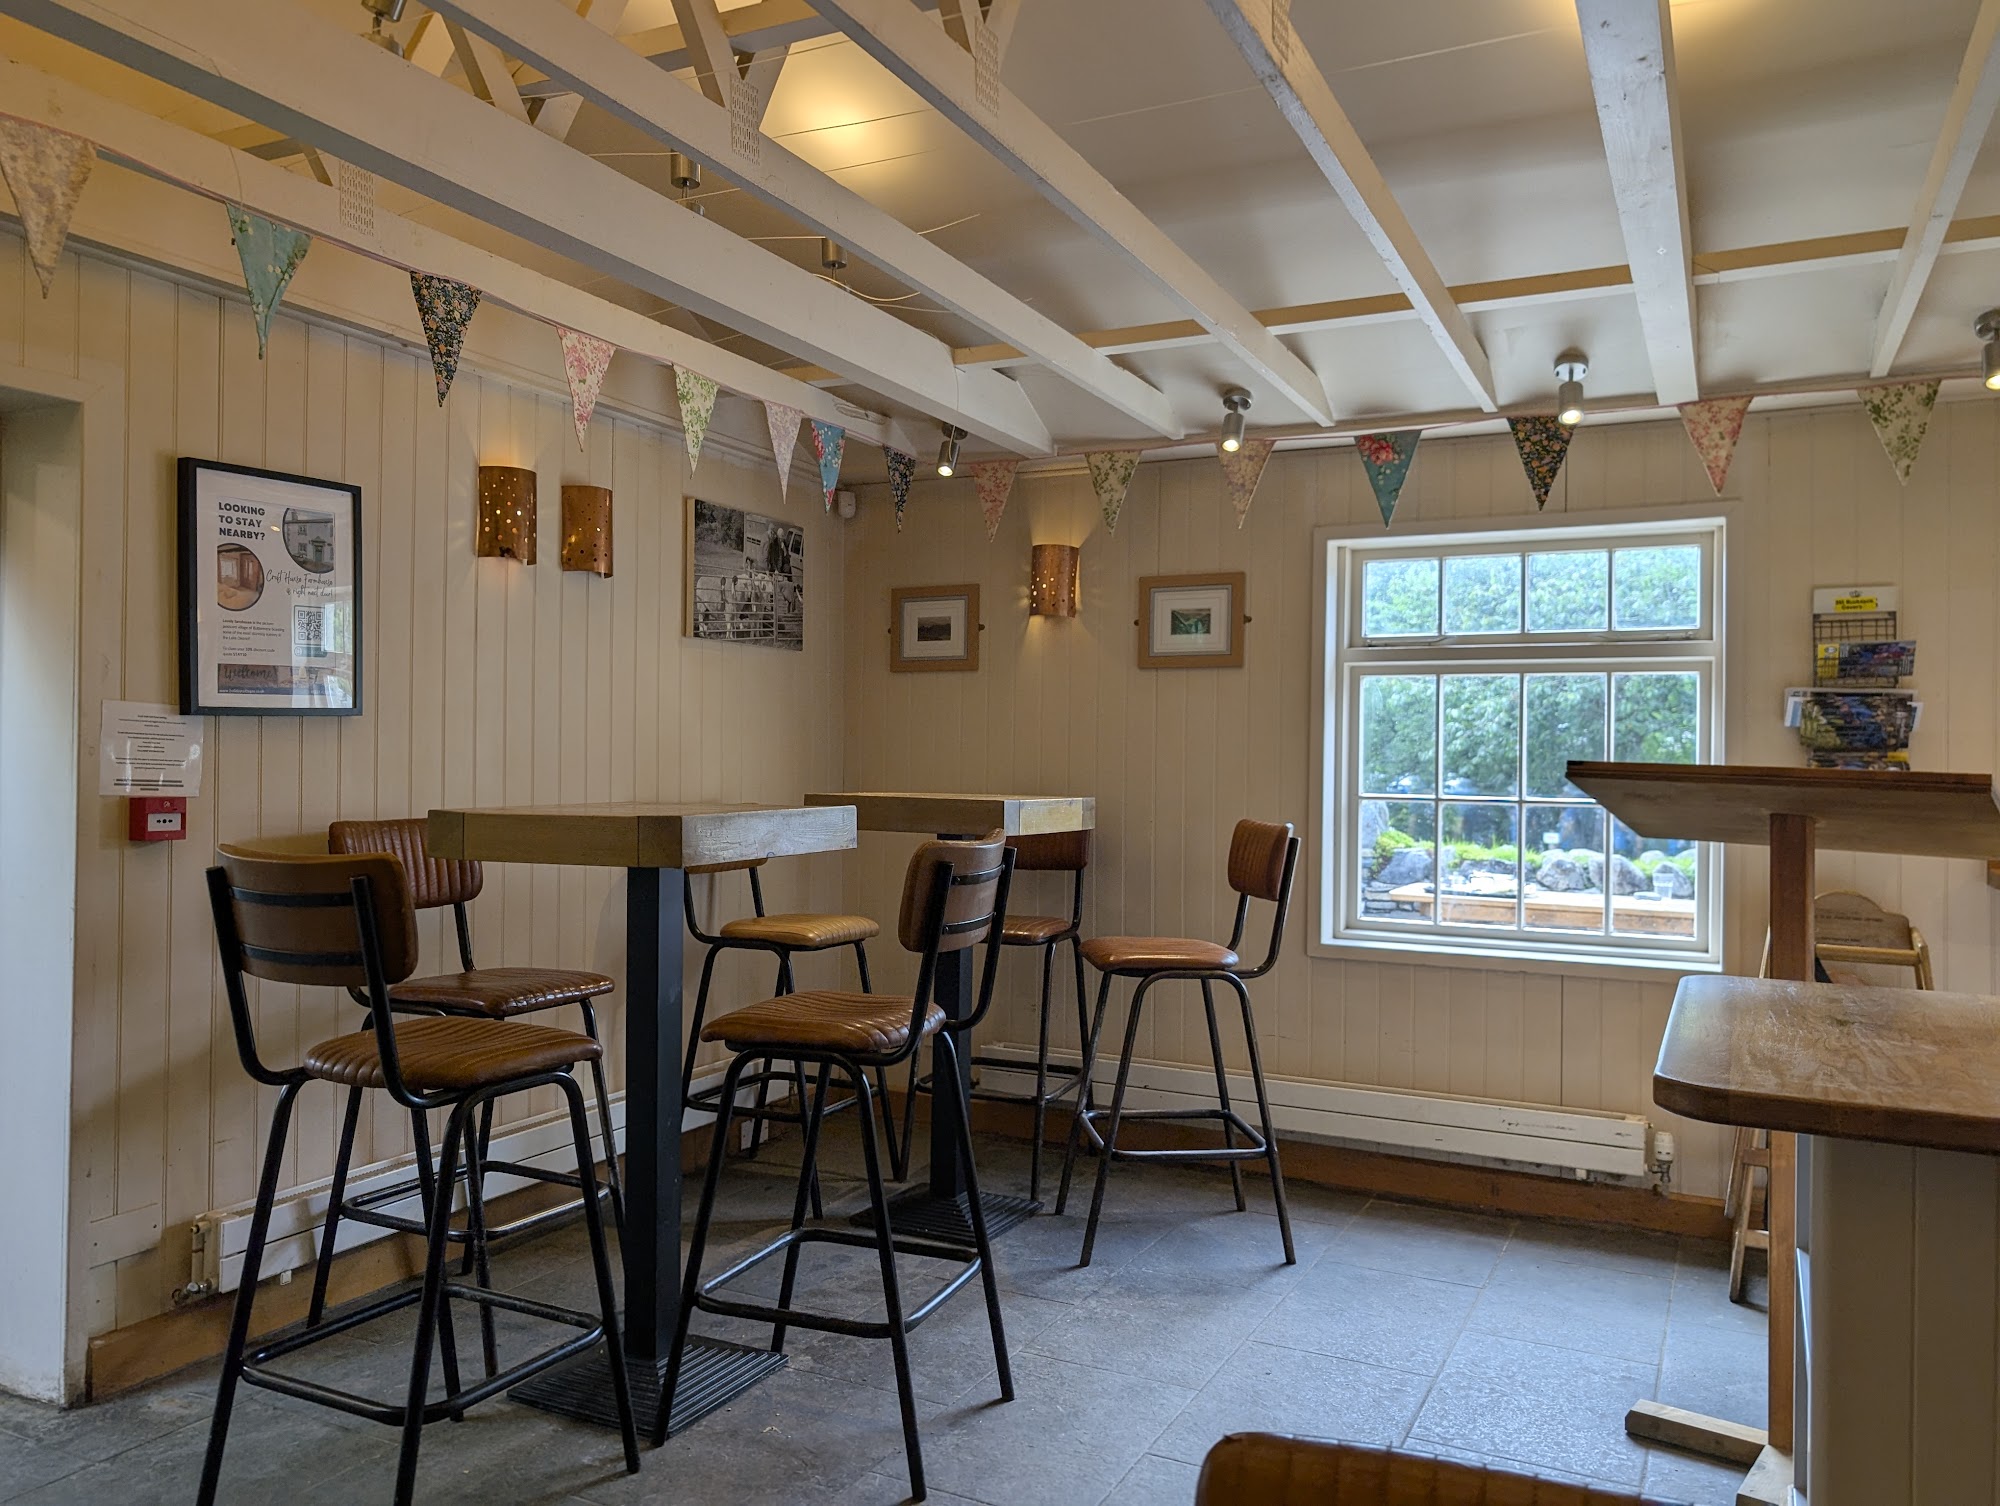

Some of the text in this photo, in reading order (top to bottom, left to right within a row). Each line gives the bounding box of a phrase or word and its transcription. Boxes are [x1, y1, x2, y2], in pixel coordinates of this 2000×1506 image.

[219, 502, 265, 516] LOOKING
[219, 515, 262, 528] TO STAY
[219, 527, 265, 541] NEARBY?
[266, 569, 333, 589] Croft House Farmhouse
[293, 585, 308, 598] right
[307, 586, 321, 597] next
